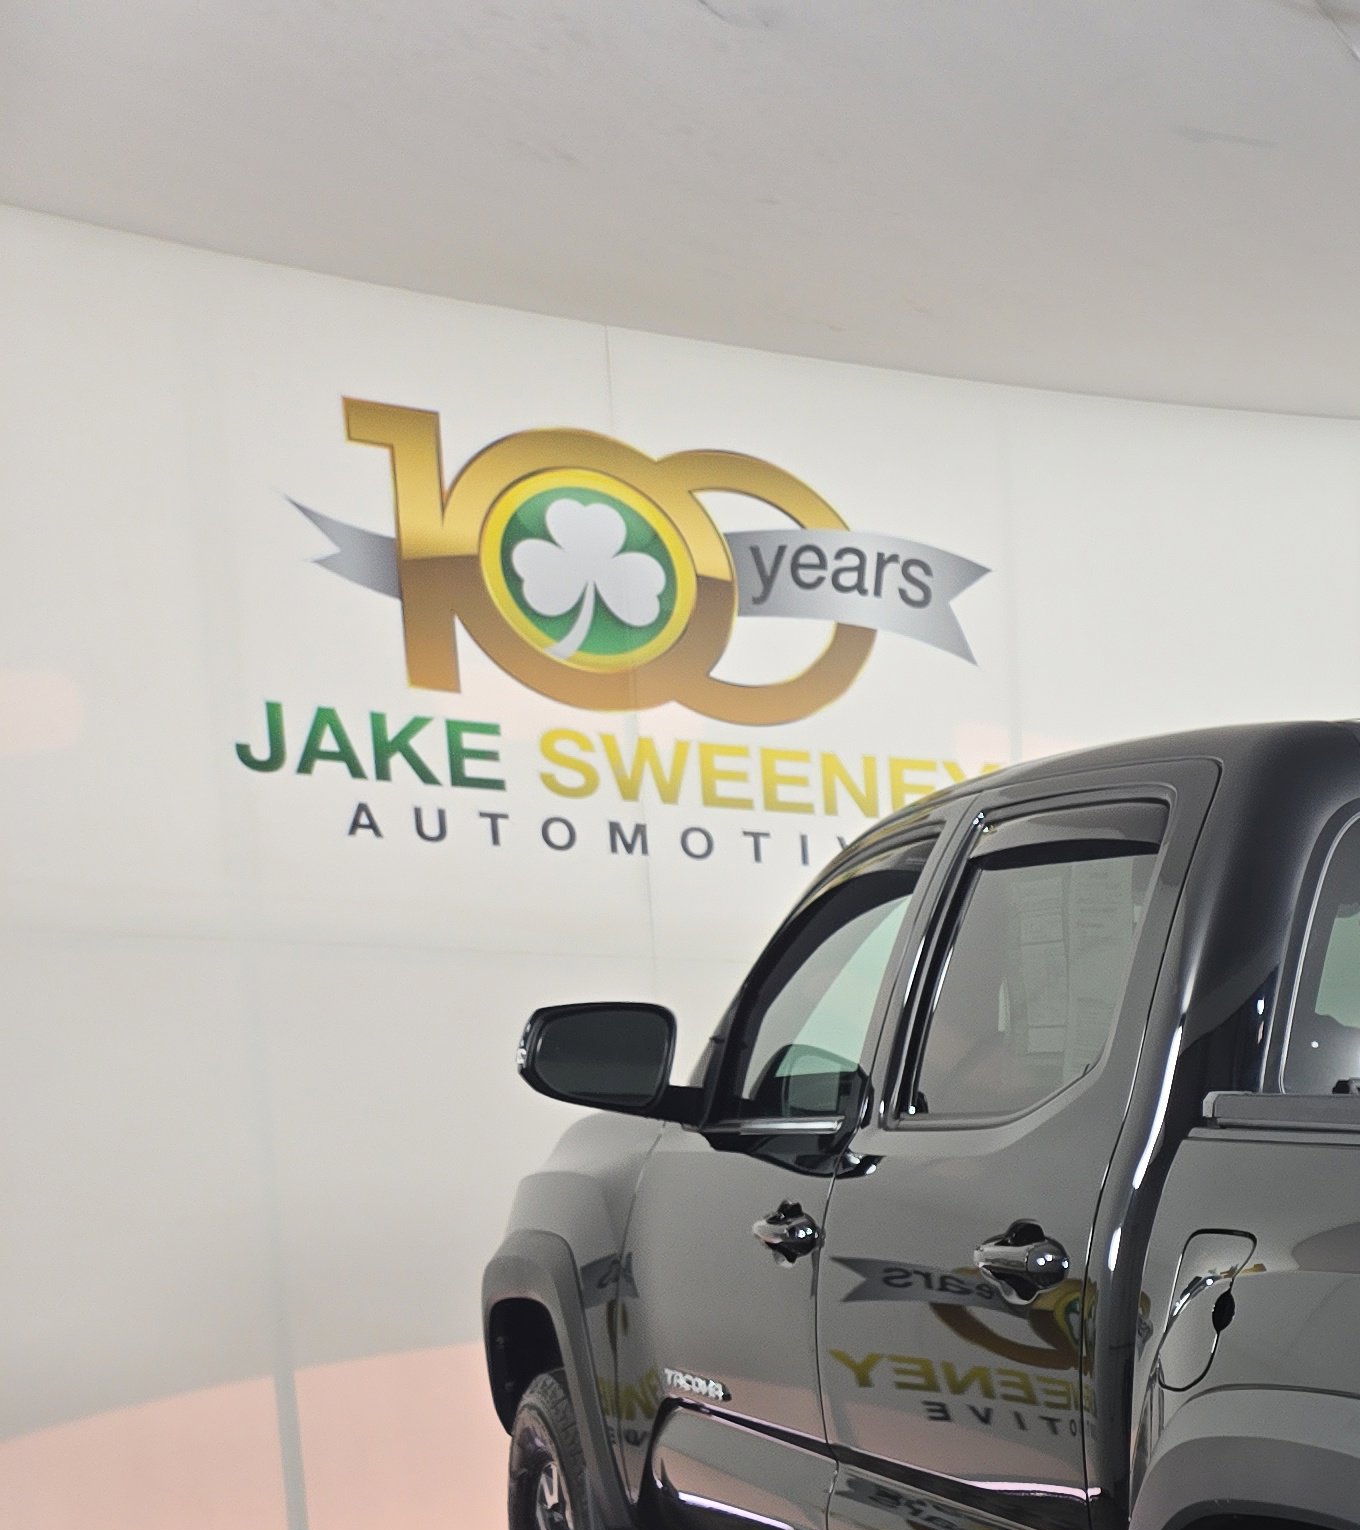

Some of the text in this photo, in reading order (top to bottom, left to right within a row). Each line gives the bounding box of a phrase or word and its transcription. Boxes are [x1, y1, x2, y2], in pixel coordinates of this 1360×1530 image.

[750, 541, 933, 608] years
[235, 701, 507, 792] JAKE
[347, 802, 850, 866] AUTOMOTI
